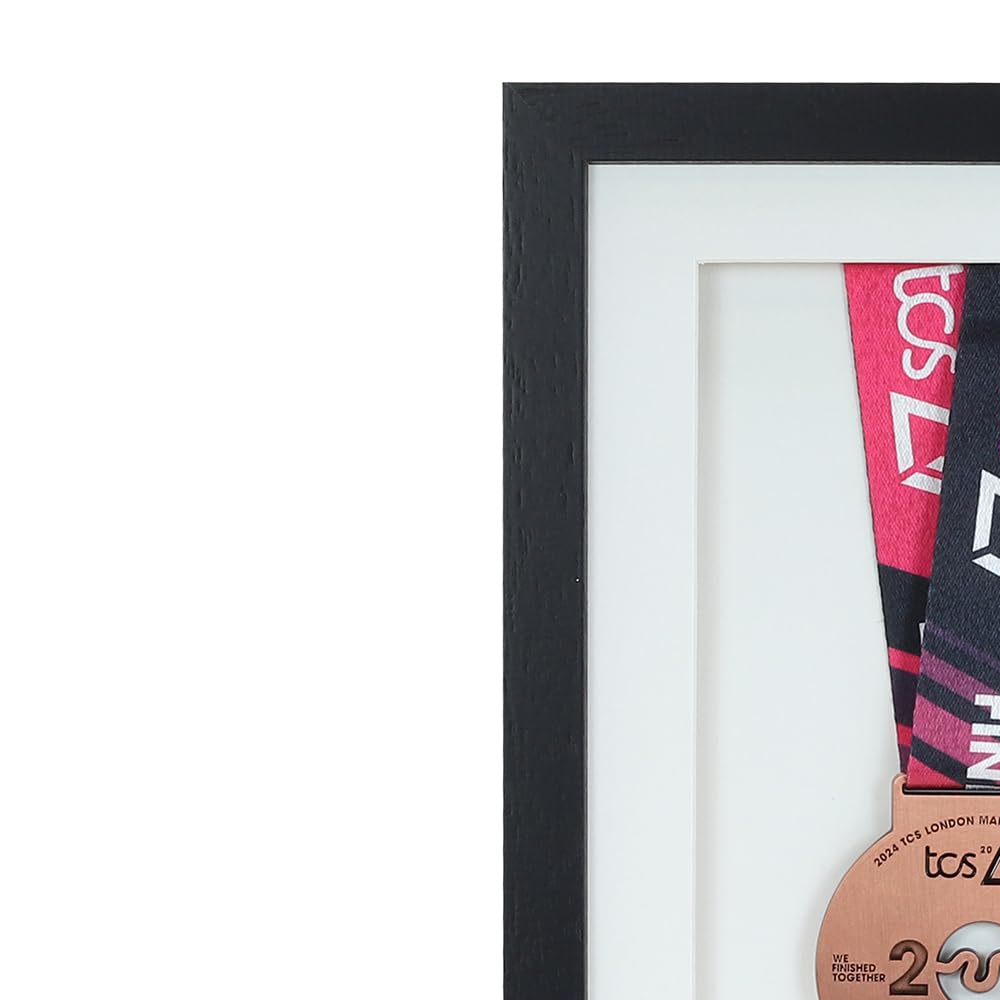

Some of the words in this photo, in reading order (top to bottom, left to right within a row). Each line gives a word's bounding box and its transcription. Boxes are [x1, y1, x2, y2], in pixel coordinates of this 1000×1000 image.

[893, 264, 964, 381] tcs
[873, 843, 899, 867] 2024
[900, 830, 922, 846] TCS
[924, 816, 974, 835] LONDON
[925, 845, 977, 878] tcs
[980, 845, 992, 854] 20
[832, 963, 876, 973] FINISHED
[833, 954, 849, 963] WE
[832, 973, 886, 982] TOGETHER
